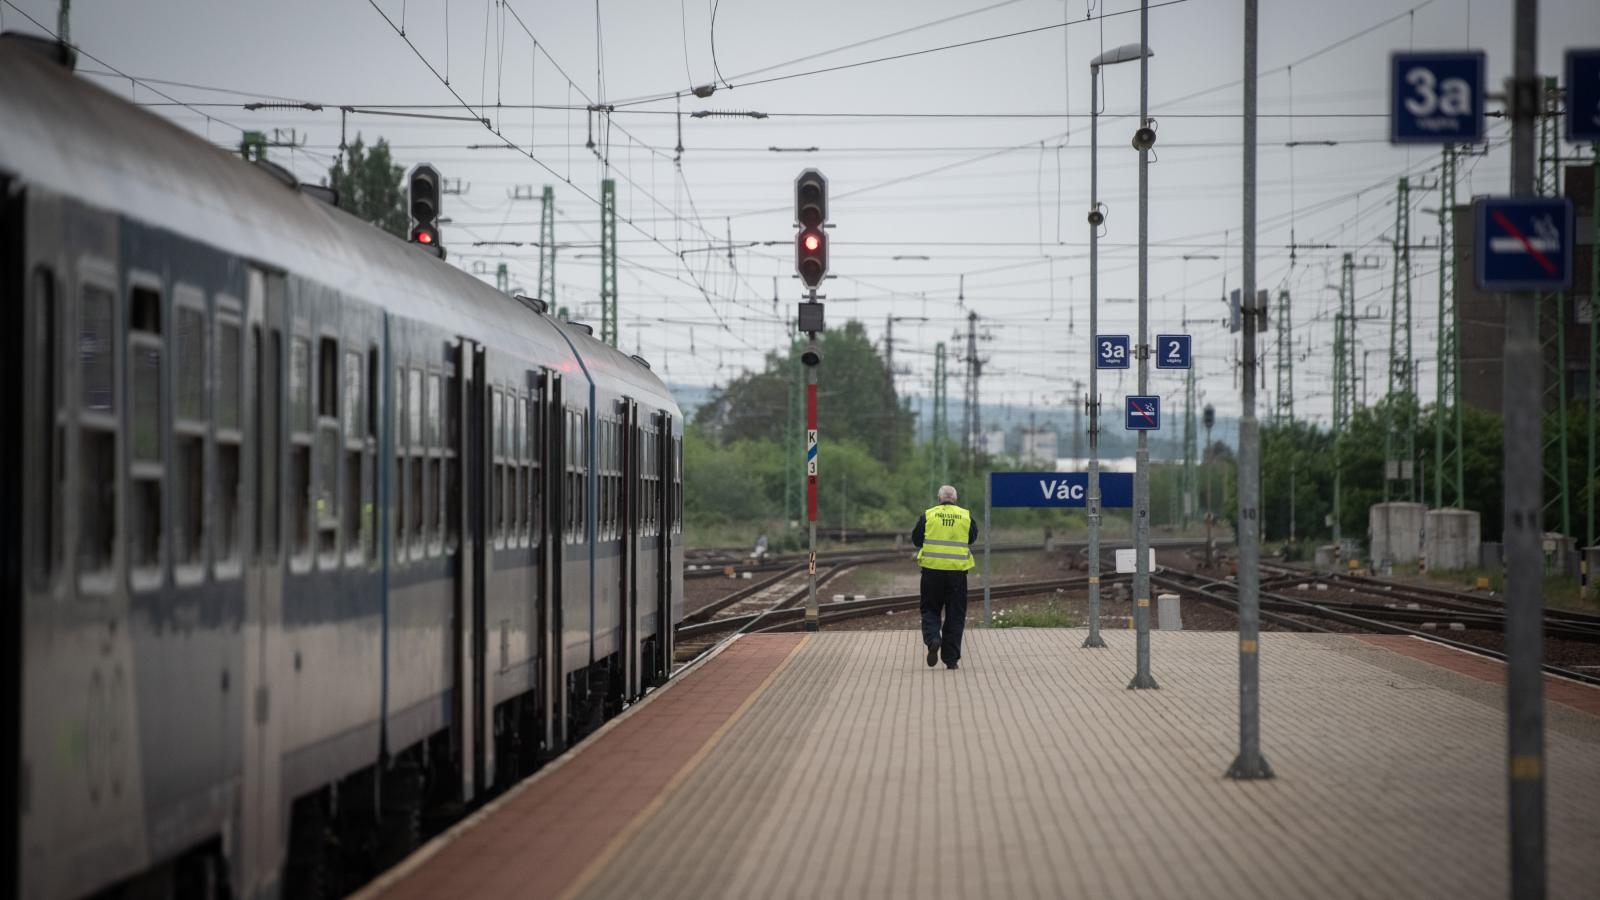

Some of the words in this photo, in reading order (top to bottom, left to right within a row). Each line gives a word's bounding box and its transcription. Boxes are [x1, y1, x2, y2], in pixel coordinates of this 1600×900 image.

[1405, 66, 1473, 116] 3a
[1101, 341, 1125, 358] 3a
[1168, 341, 1180, 358] 2
[809, 431, 816, 443] K
[810, 462, 816, 474] 3
[1040, 480, 1083, 499] Vác
[1242, 508, 1256, 521] 10
[942, 518, 955, 527] 1117
